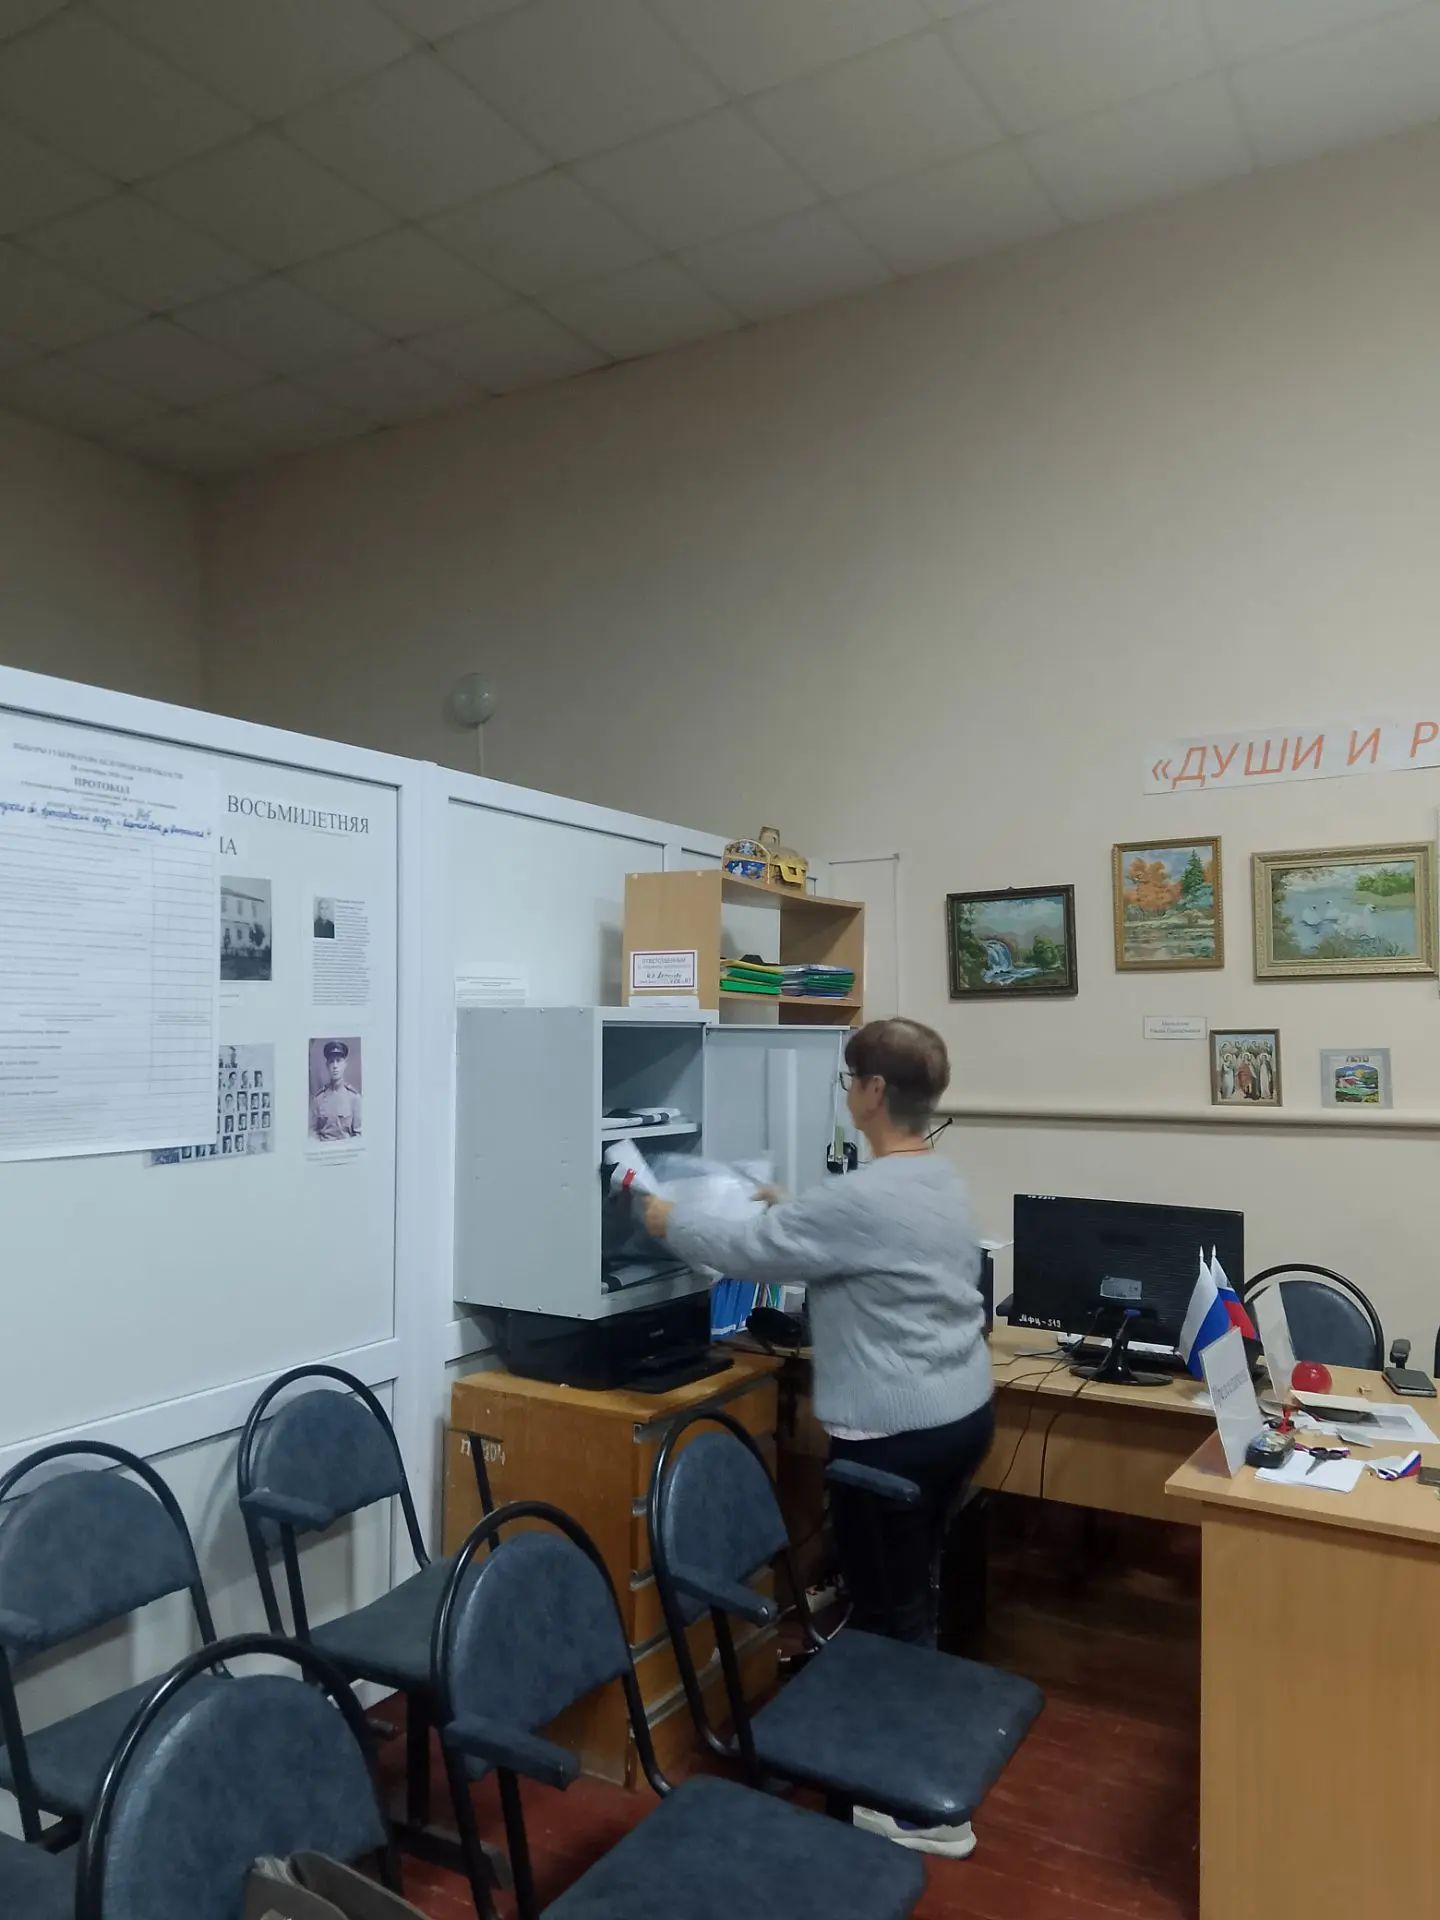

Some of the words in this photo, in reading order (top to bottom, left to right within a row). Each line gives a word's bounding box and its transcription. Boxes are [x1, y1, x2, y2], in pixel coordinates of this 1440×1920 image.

[1151, 733, 1325, 790] «ДУШИ
[1346, 727, 1381, 766] И
[227, 795, 370, 834] ВОСЬМИЛЕТНЯЯ
